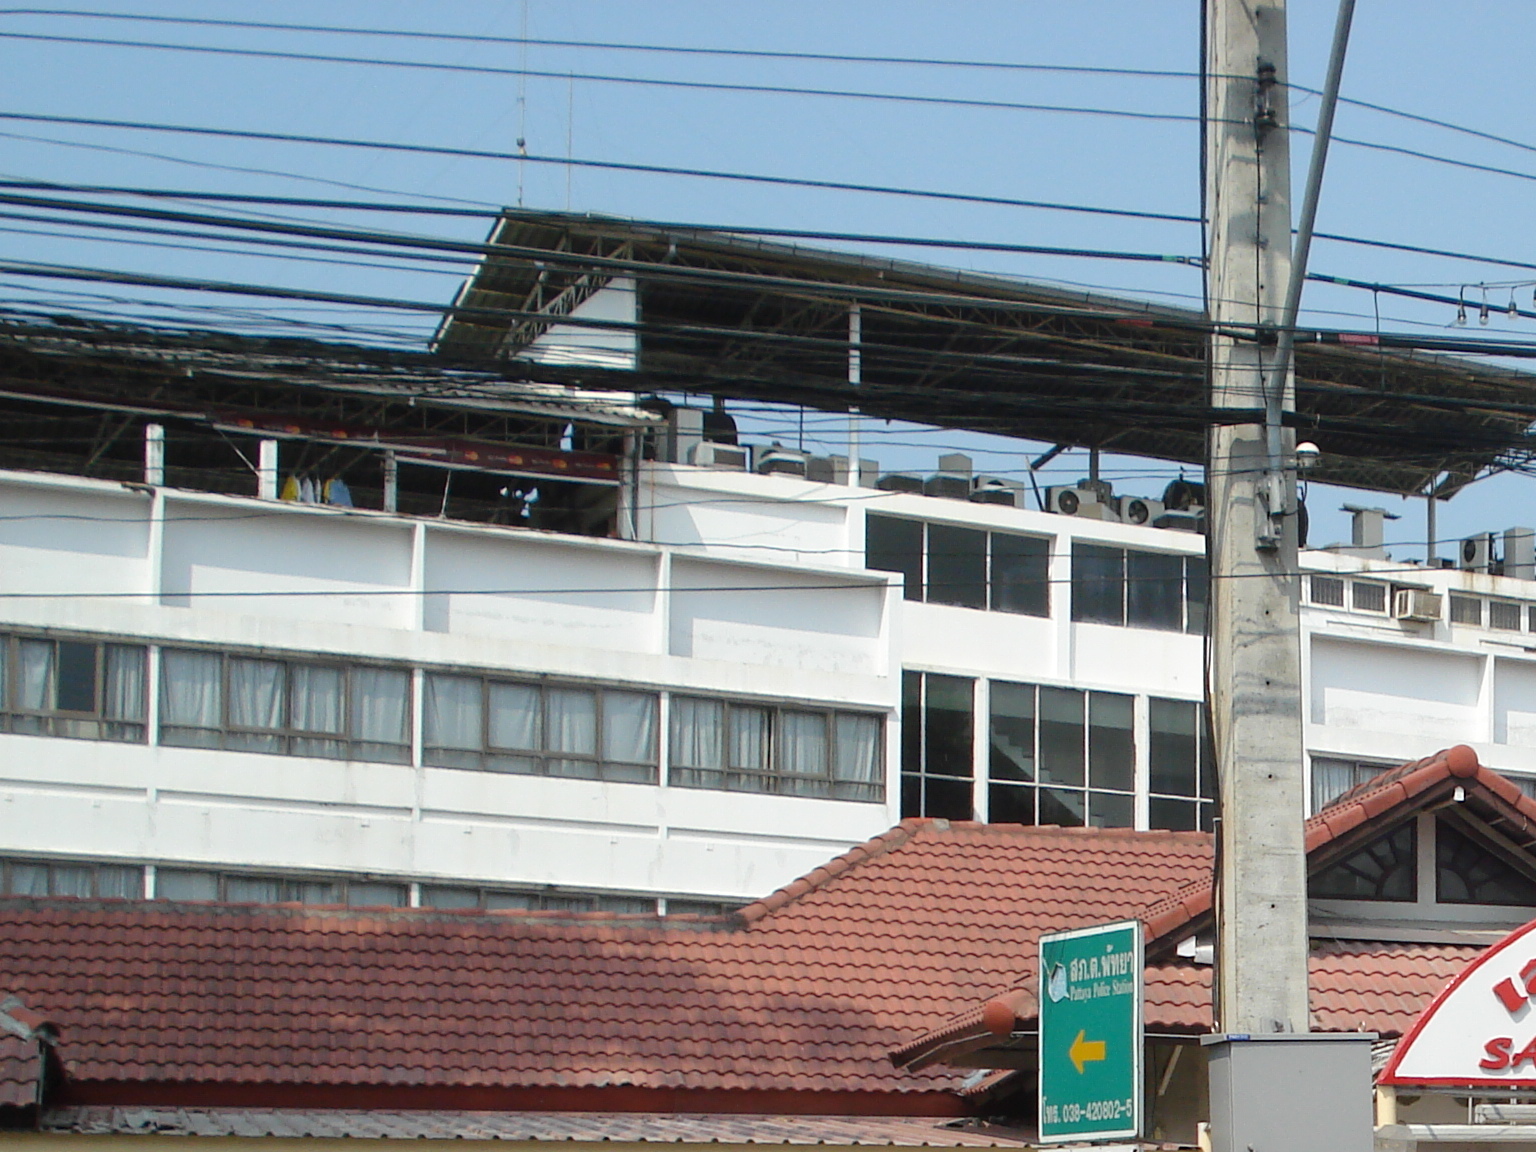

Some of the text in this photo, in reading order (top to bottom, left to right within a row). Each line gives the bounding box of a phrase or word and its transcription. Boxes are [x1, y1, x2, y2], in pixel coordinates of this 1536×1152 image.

[1070, 979, 1134, 1003] Pattaya Police Station
[1062, 1099, 1133, 1123] 038-420802-5
